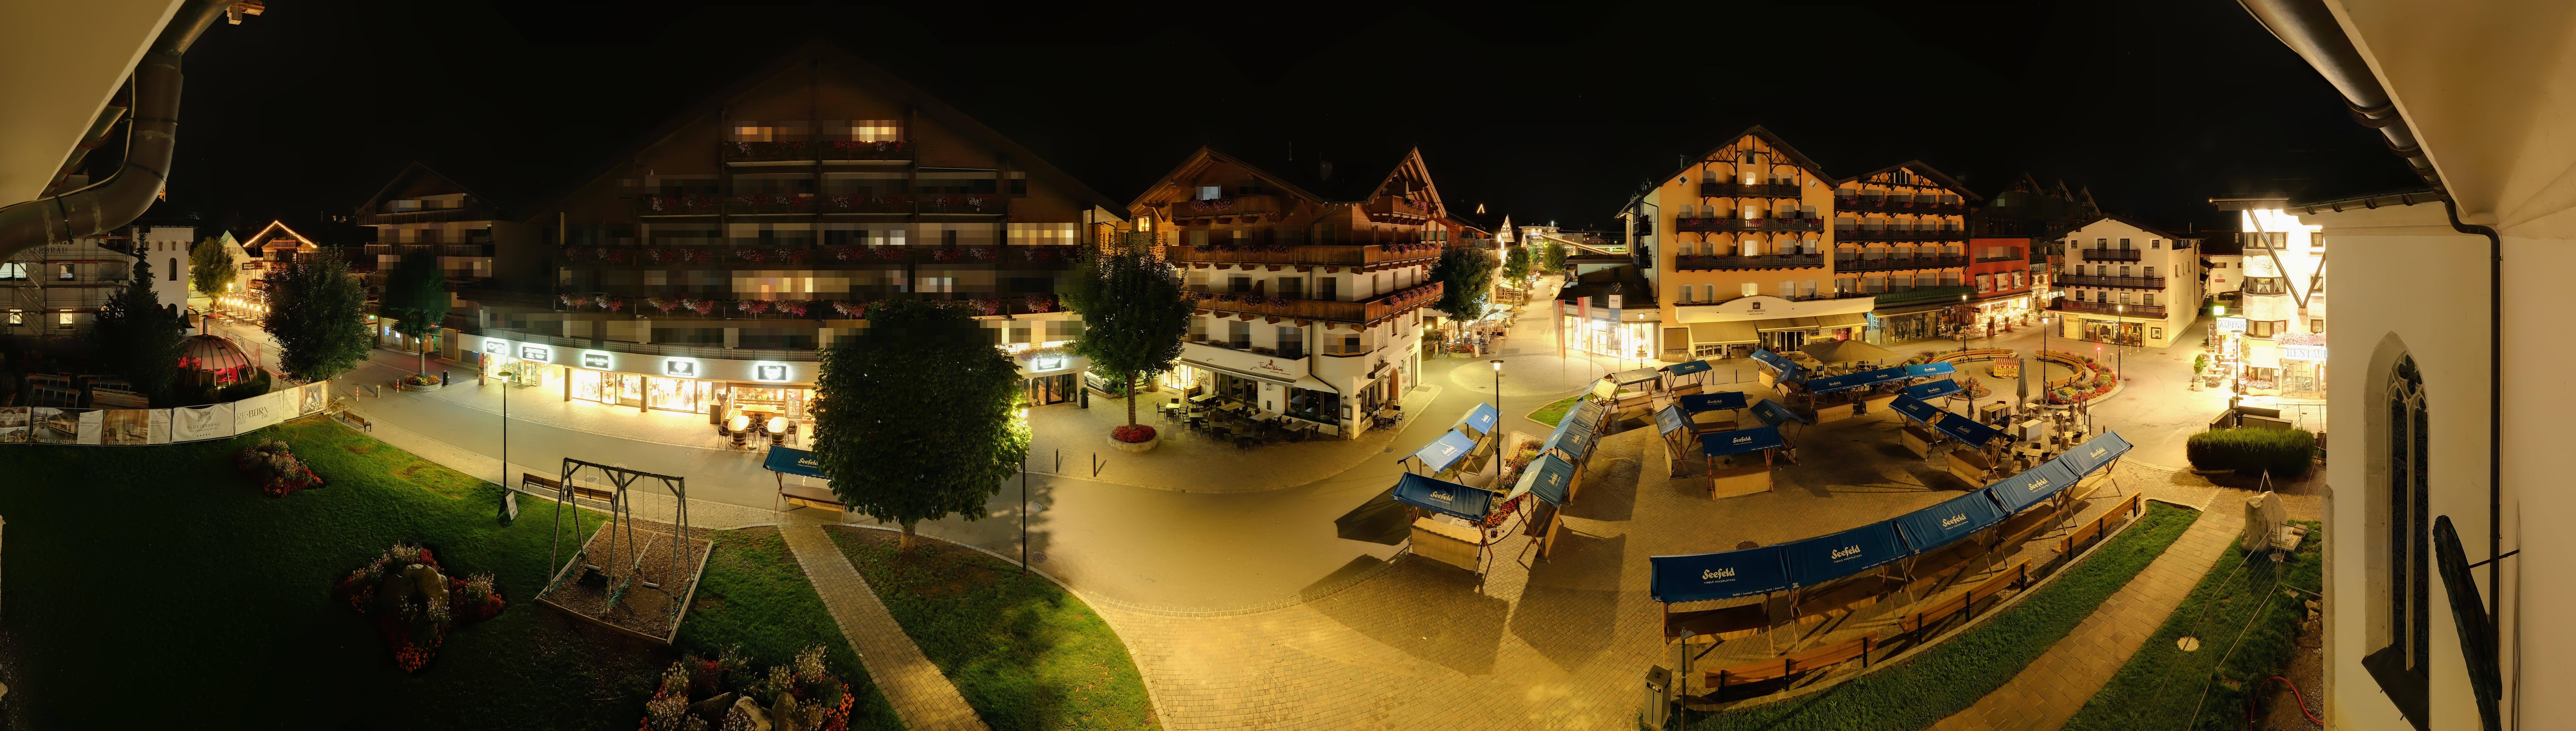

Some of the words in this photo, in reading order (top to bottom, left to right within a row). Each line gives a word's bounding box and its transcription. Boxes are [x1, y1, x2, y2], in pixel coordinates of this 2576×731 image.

[1375, 364, 1390, 377] RESTAURANT
[1442, 445, 1455, 455] Seefeld
[2090, 447, 2105, 458] Seefeld
[1548, 472, 1558, 485] Seefeld
[2028, 478, 2048, 490] Seefeld
[1430, 491, 1454, 501] Seefeld
[1943, 513, 1966, 527] Seefeld
[1831, 544, 1861, 559] Seefeld
[1702, 567, 1735, 580] Seefeld
